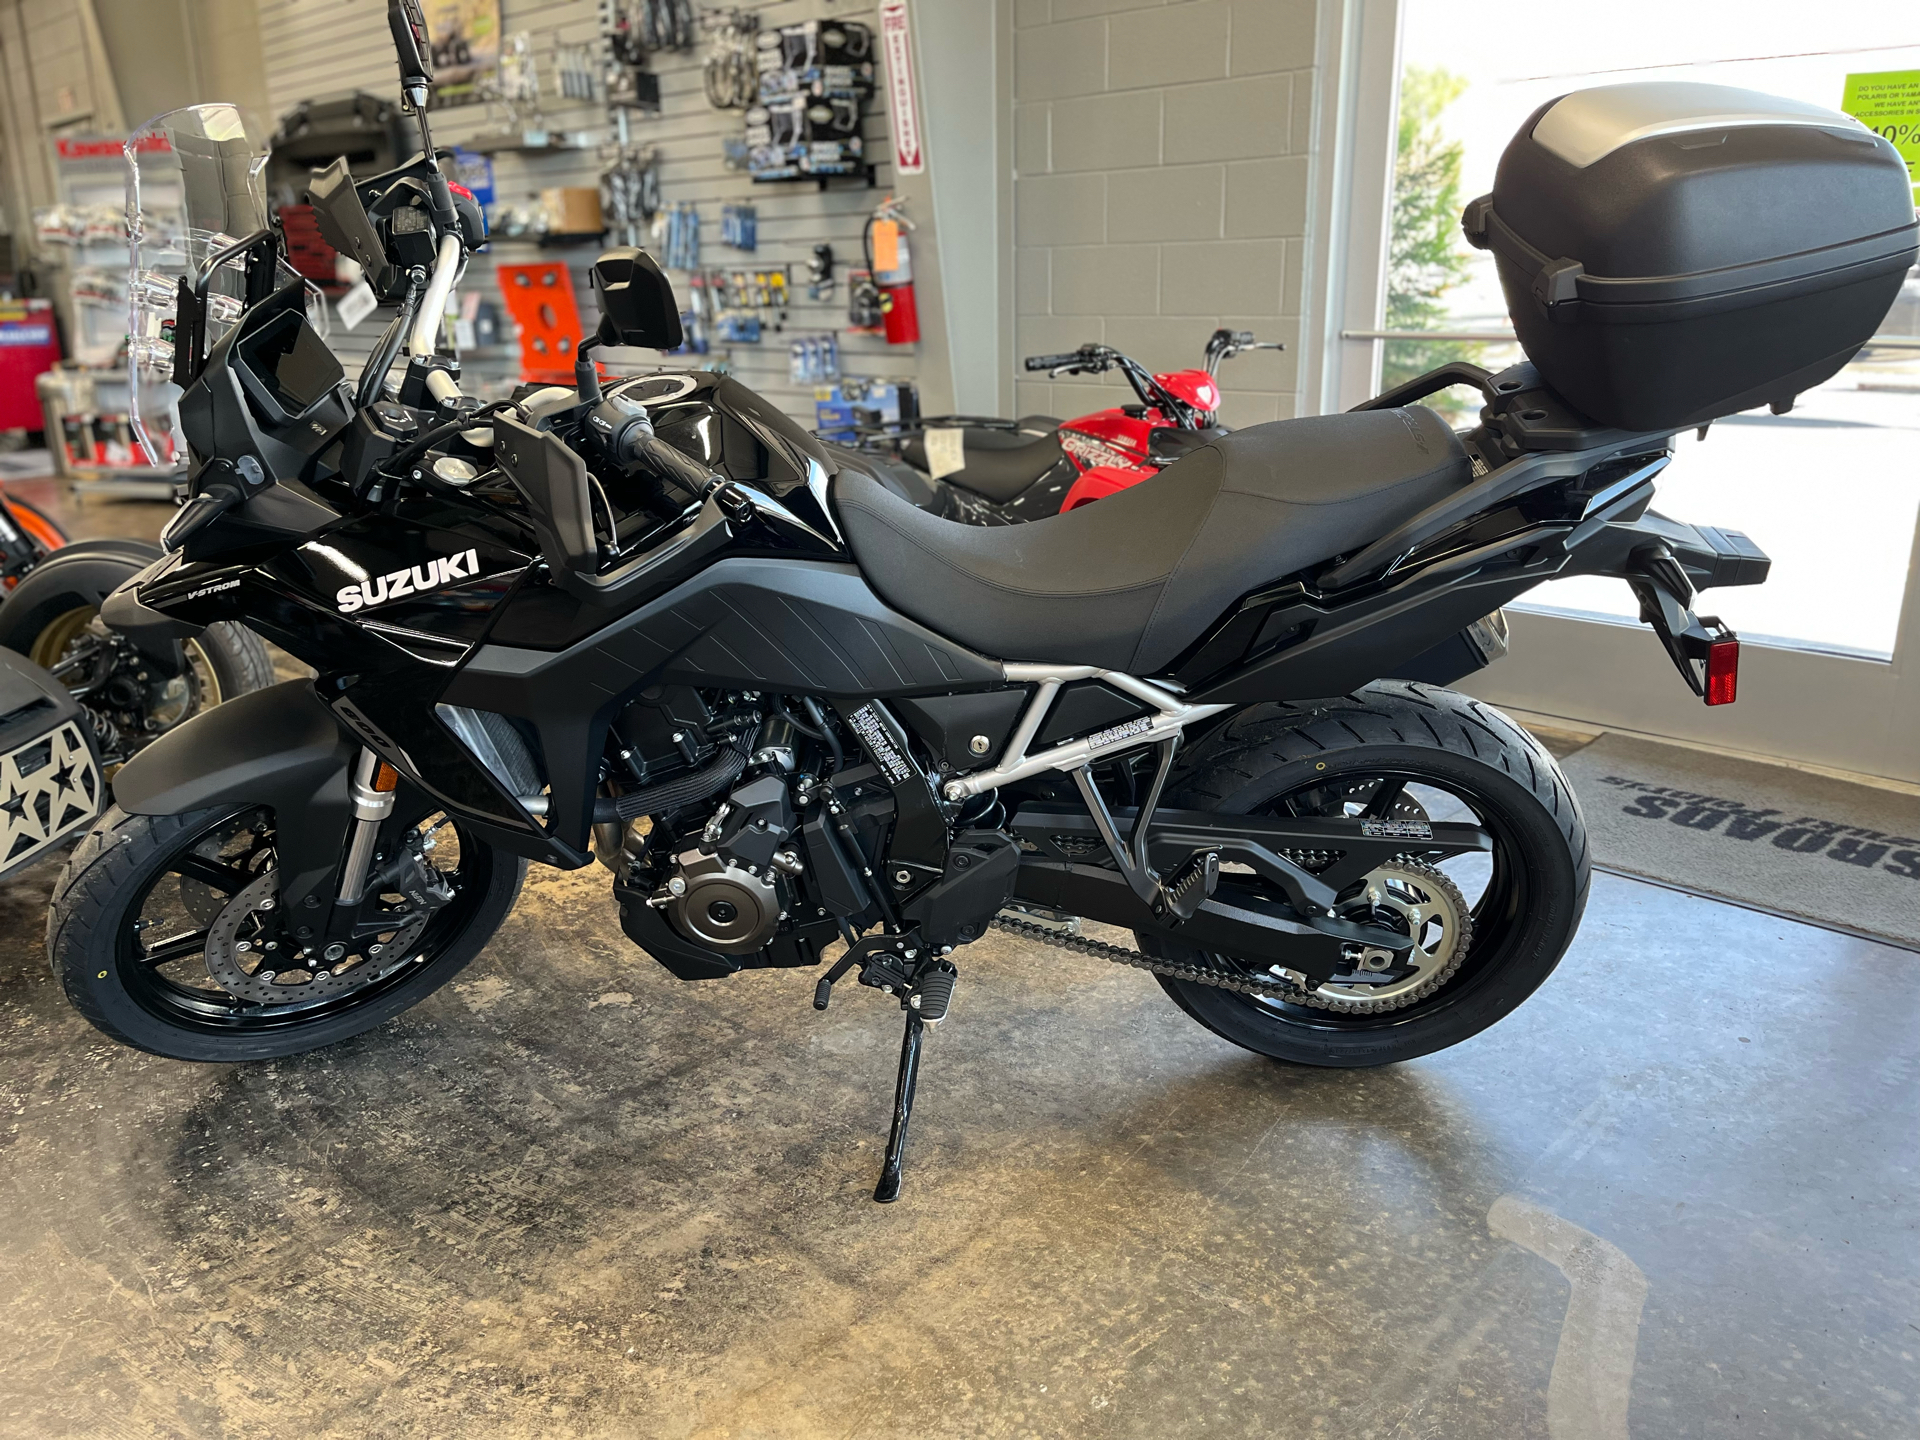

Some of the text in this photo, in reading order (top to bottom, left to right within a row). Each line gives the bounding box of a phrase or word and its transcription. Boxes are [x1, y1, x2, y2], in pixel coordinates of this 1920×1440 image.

[1061, 438, 1132, 469] GRIZZLY
[187, 579, 240, 600] V-STROM
[336, 548, 480, 613] SUZUKI
